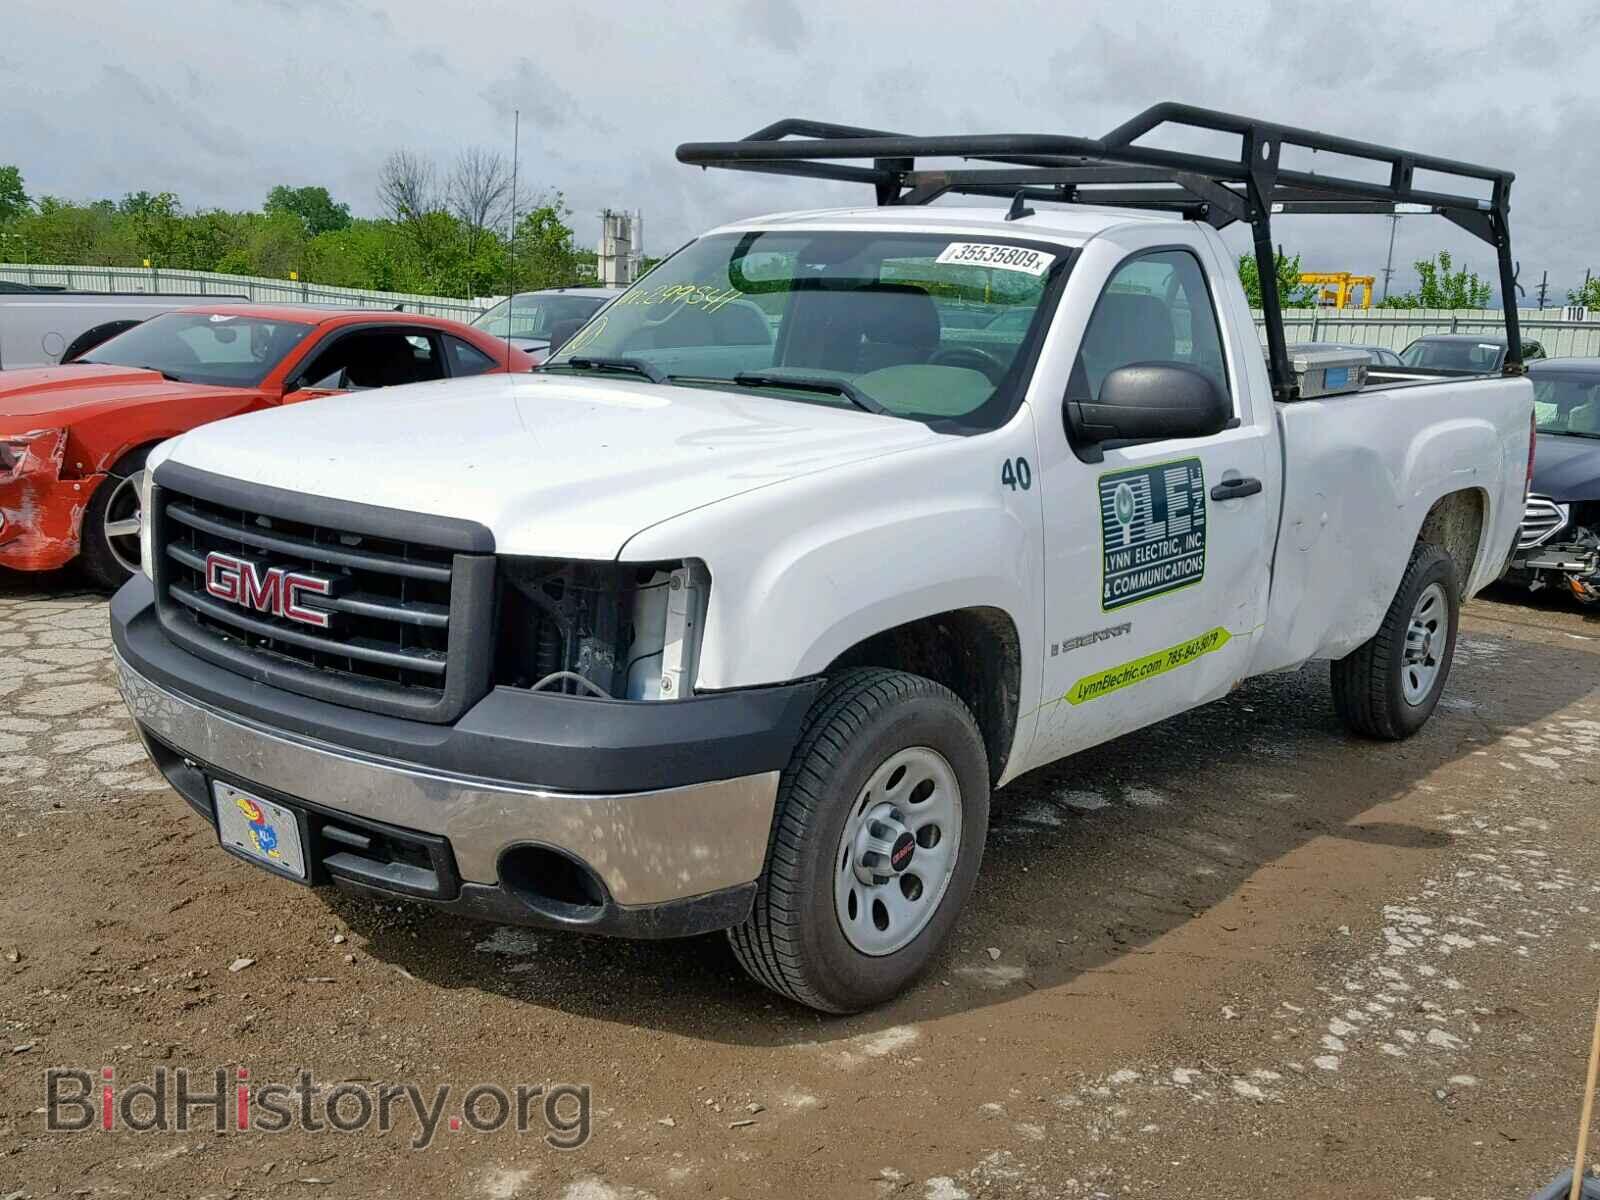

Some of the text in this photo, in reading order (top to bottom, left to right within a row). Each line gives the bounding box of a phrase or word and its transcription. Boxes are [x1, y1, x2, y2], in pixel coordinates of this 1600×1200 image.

[1568, 306, 1584, 321] 110
[1001, 456, 1031, 491] 40
[1104, 551, 1131, 573] LYNN
[1135, 537, 1182, 564] ELECTRIC,
[206, 551, 329, 628] GMC
[1103, 555, 1204, 599] & COMMUNICATIONS
[1077, 659, 1162, 701] LynnElectric.com
